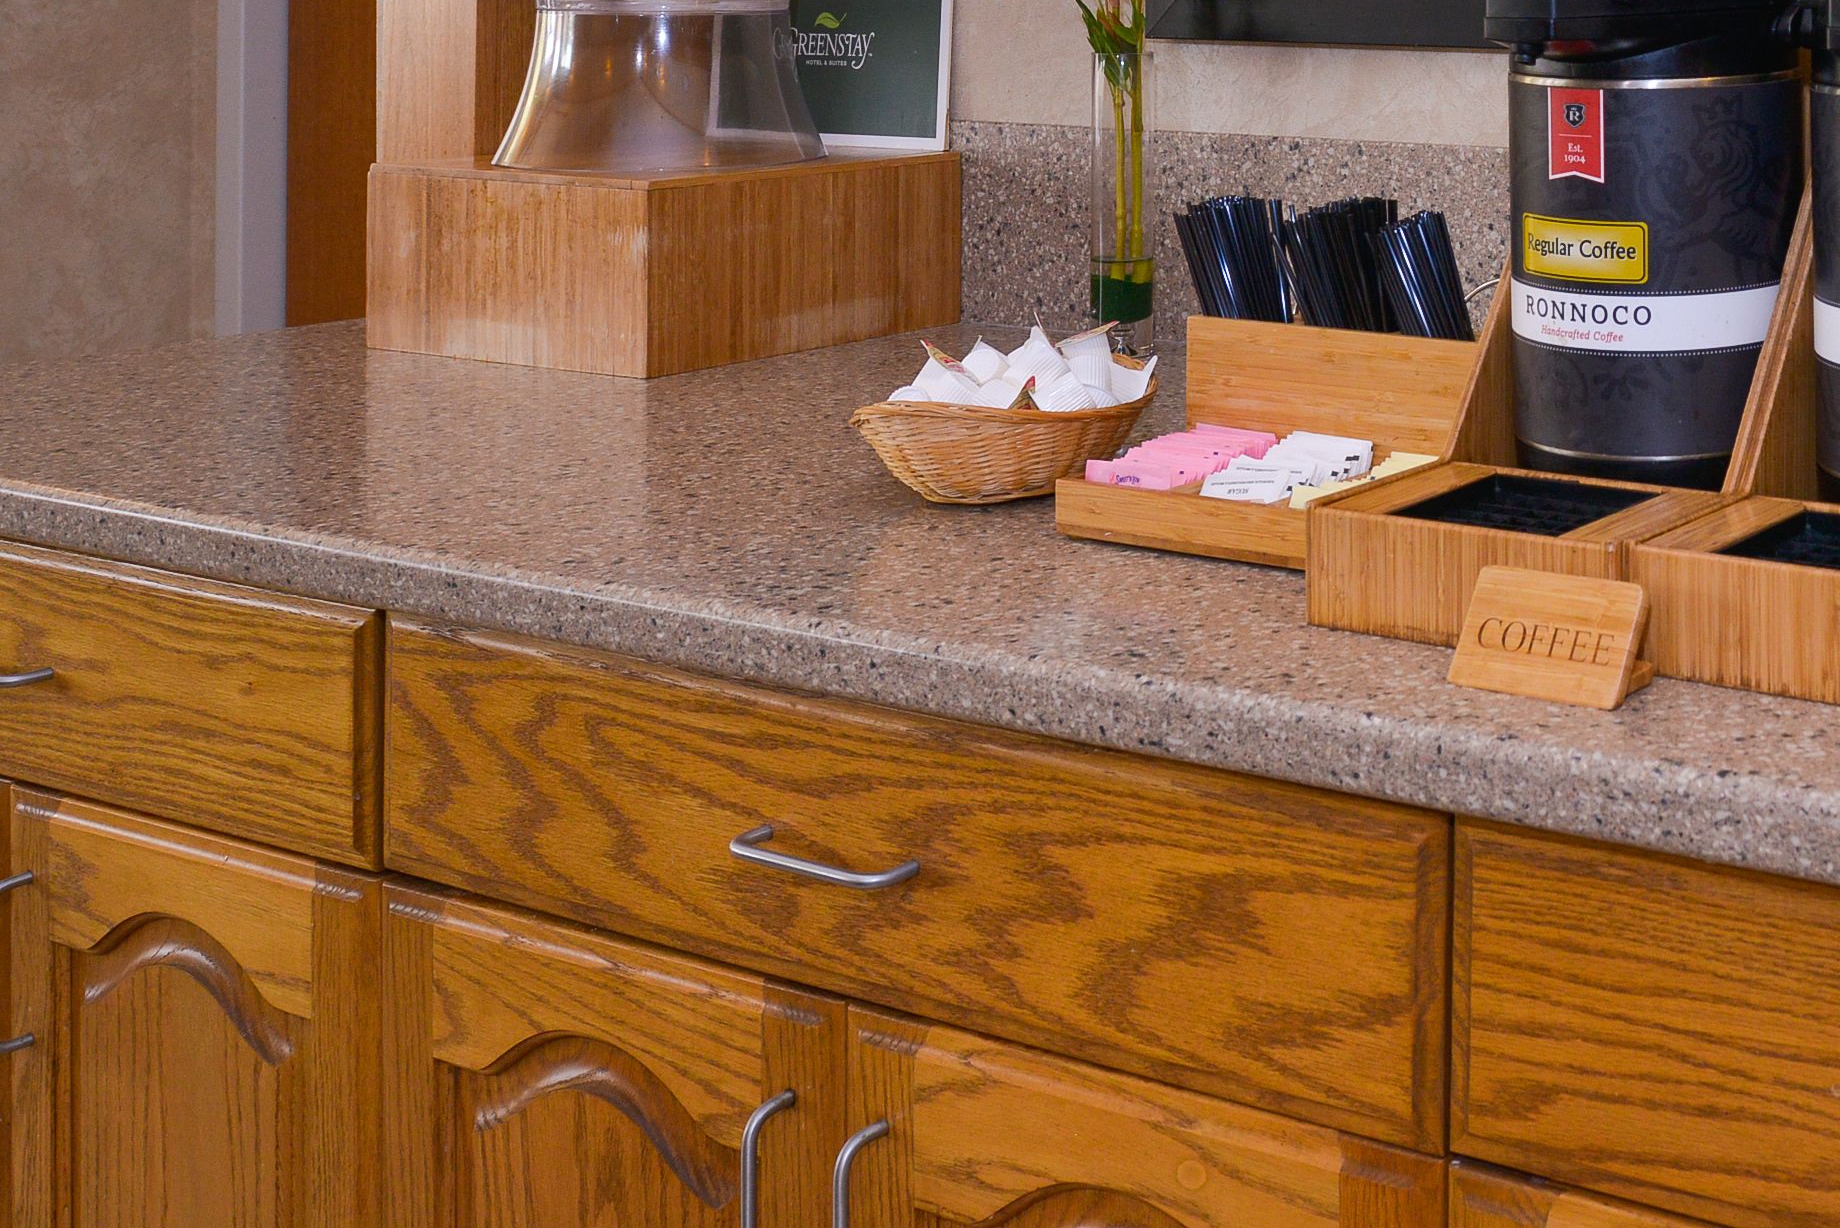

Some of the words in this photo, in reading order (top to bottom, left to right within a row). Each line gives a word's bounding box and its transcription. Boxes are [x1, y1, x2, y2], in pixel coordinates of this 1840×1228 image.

[829, 59, 847, 67] SUITES
[1568, 110, 1580, 122] R
[1567, 142, 1584, 153] Est.
[1564, 154, 1586, 166] 1904
[1528, 232, 1574, 257] Regular
[1579, 239, 1637, 260] Coffee
[1526, 294, 1651, 325] RONNOCO
[1541, 324, 1590, 341] Handcrafted
[1593, 331, 1624, 344] Coffee
[1477, 617, 1615, 667] COFFEE
